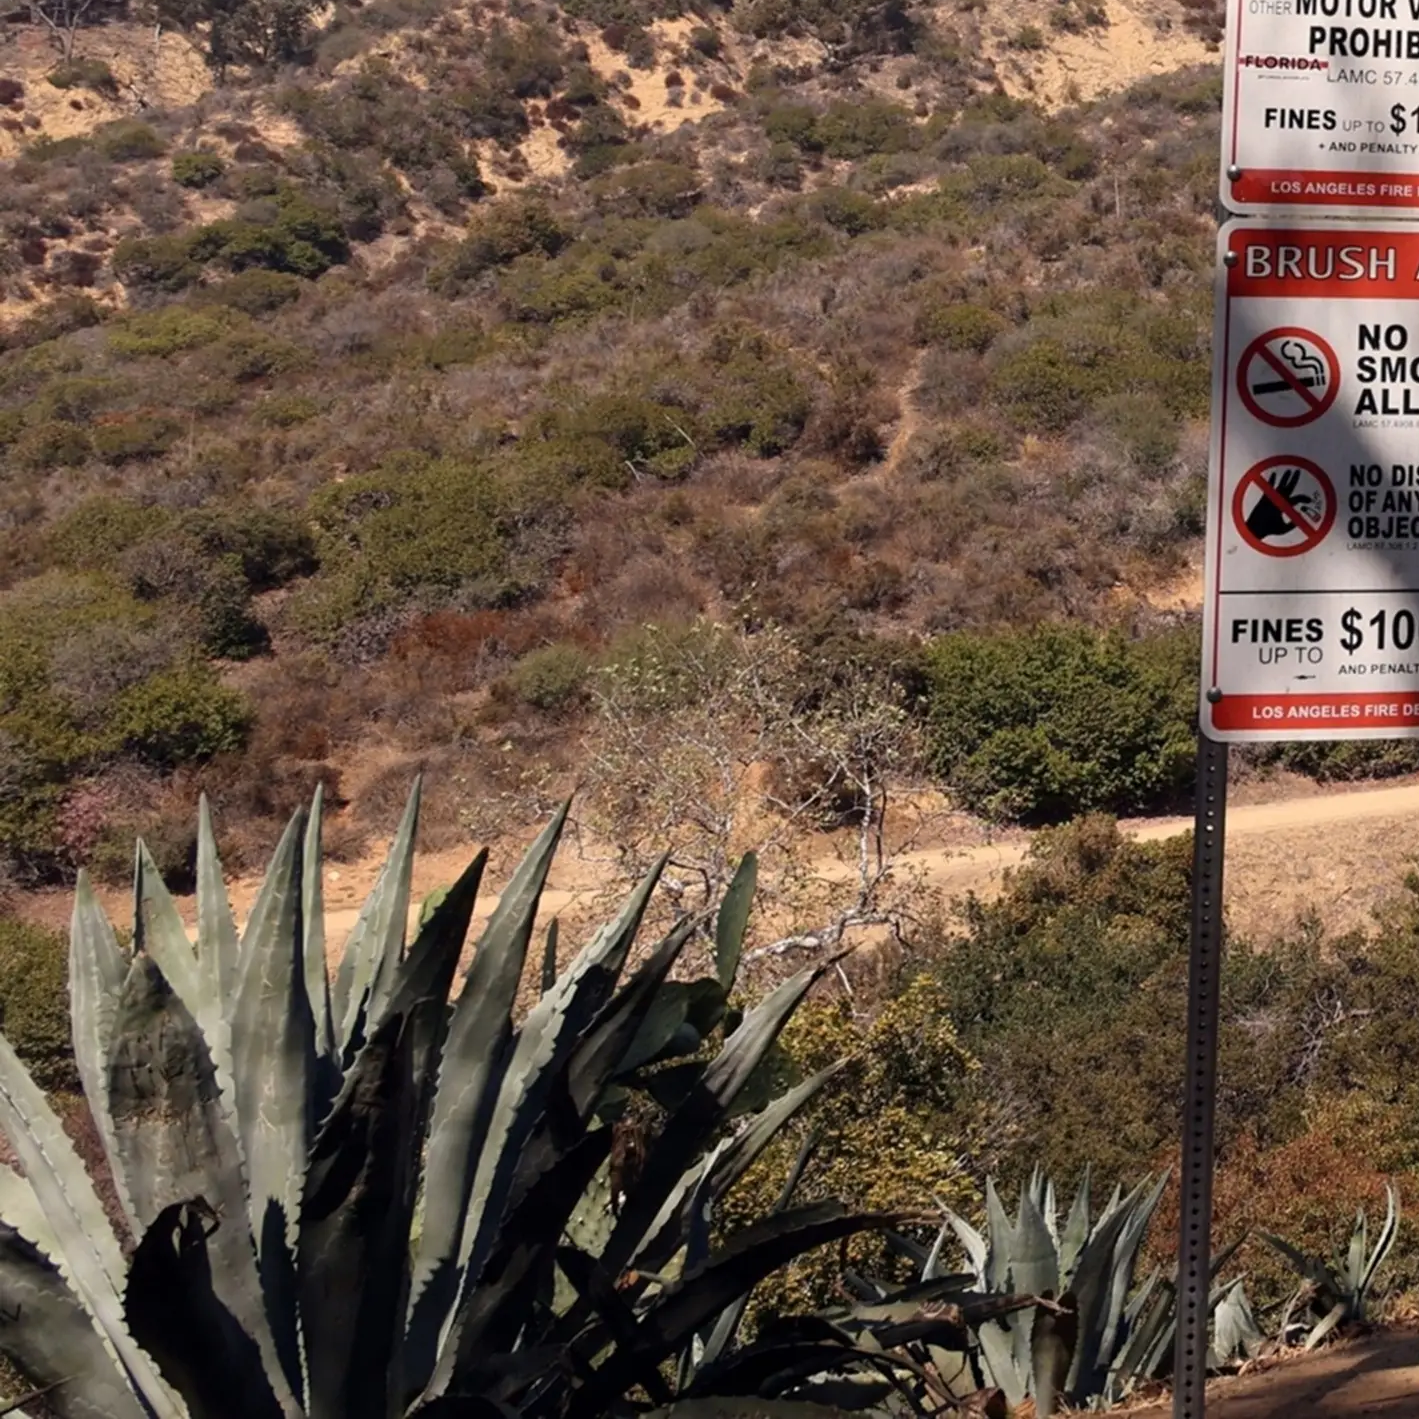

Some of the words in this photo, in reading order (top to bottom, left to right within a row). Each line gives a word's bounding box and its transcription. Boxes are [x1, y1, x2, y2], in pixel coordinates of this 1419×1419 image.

[1249, 0, 1292, 15] OTHER
[1245, 55, 1321, 71] FLORIDA
[1265, 108, 1336, 130] FINES
[1342, 120, 1361, 132] UP
[1367, 120, 1385, 133] TO
[1328, 141, 1357, 153] AND
[1360, 142, 1417, 155] PENALTY
[1271, 181, 1301, 194] LOS
[1305, 183, 1375, 196] ANGELES
[1380, 184, 1413, 197] FIRE
[1246, 245, 1396, 280] BRUSH
[1358, 324, 1408, 351] NO
[1350, 465, 1383, 487] NO
[1348, 490, 1377, 513] OF
[1232, 618, 1323, 643] FINES
[1258, 648, 1288, 664] UP
[1295, 647, 1323, 664] TO
[1338, 664, 1367, 675] AND
[1252, 706, 1283, 719] LOS
[1287, 704, 1360, 718] ANGELES
[1364, 704, 1399, 717] FIRE
